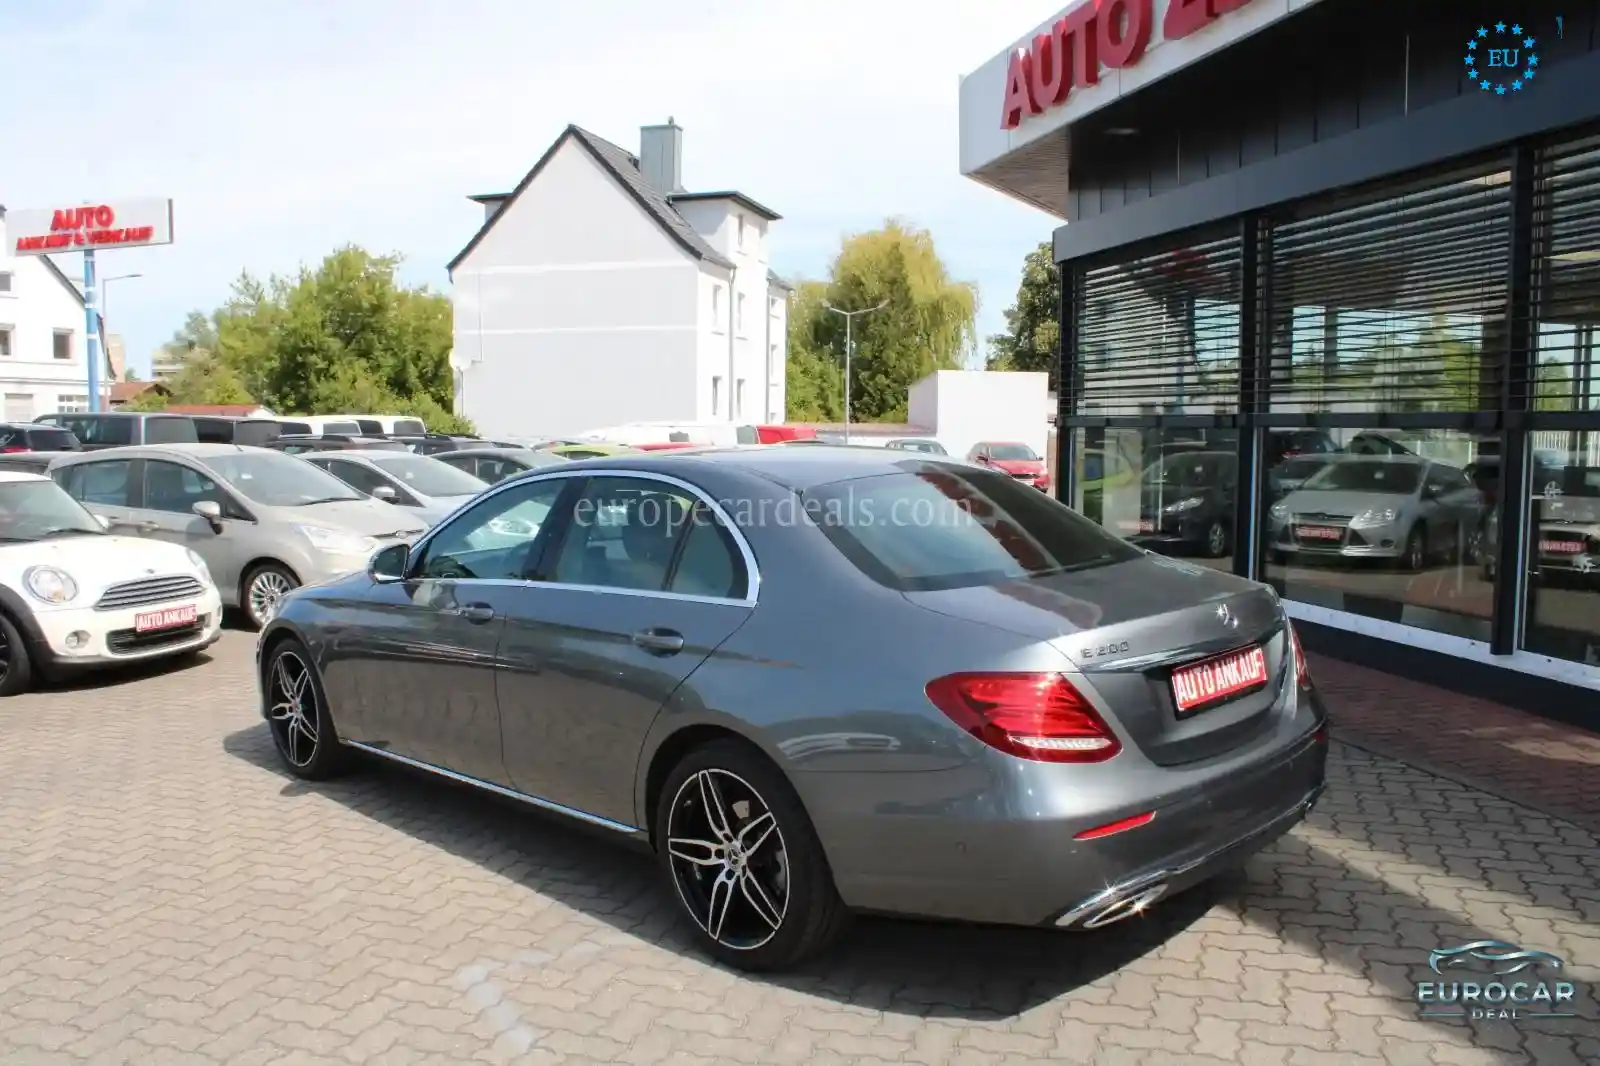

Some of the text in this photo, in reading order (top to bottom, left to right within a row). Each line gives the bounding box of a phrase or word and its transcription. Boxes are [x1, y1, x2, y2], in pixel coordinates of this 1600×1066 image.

[1000, 0, 1152, 130] AUTO
[51, 205, 115, 231] AUTO
[137, 613, 163, 630] AUTO
[1080, 640, 1131, 660] E 200
[1175, 647, 1264, 702] AUTO ANKAUF
